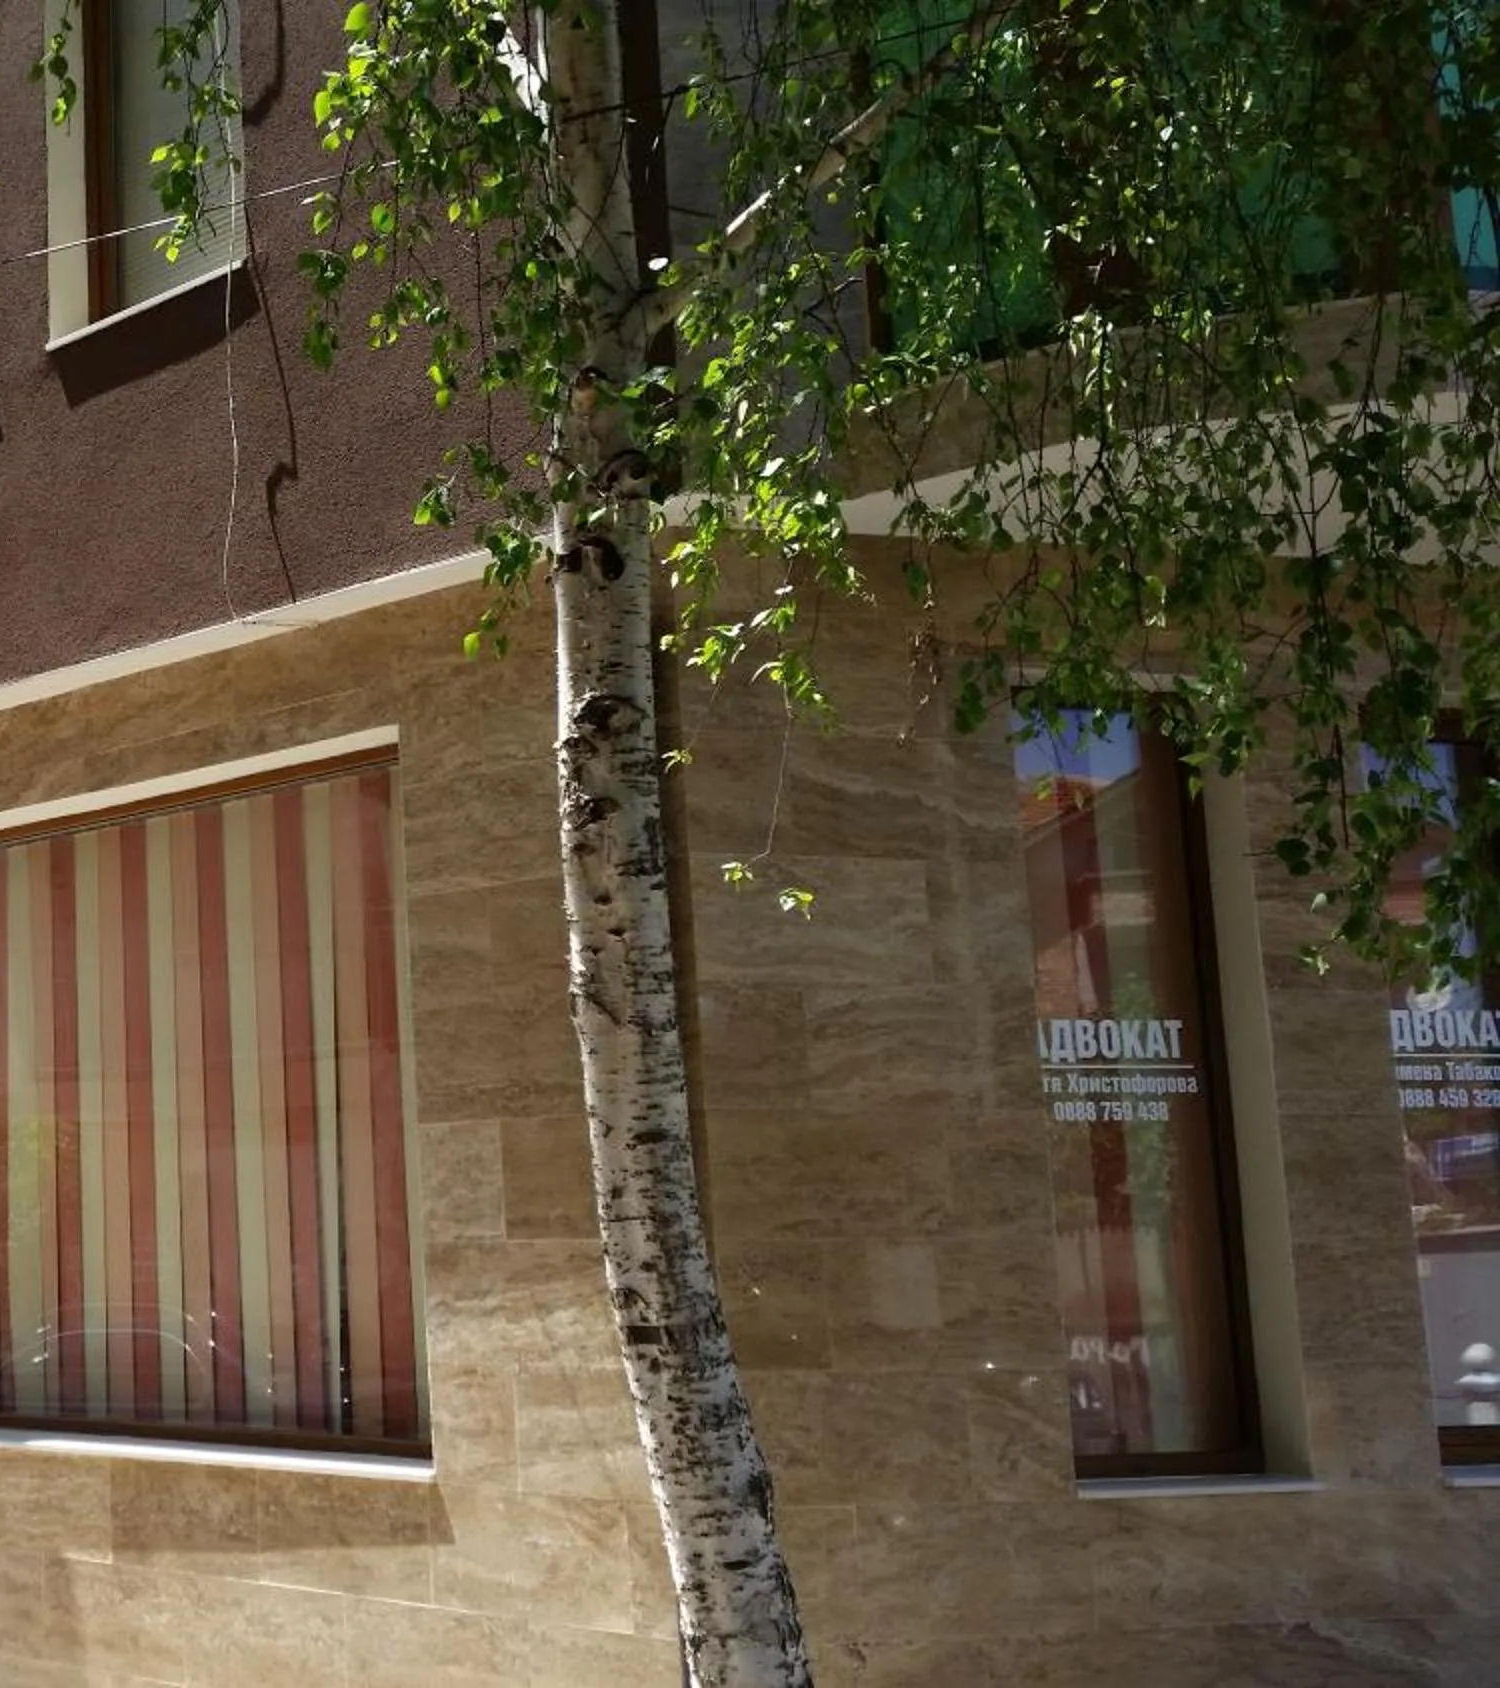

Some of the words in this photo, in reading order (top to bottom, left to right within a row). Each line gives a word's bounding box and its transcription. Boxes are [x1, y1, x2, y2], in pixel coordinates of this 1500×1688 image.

[1390, 1009, 1500, 1052] ДВОКА
[1067, 1072, 1199, 1096] Христофорова
[1053, 1101, 1097, 1121] 0888
